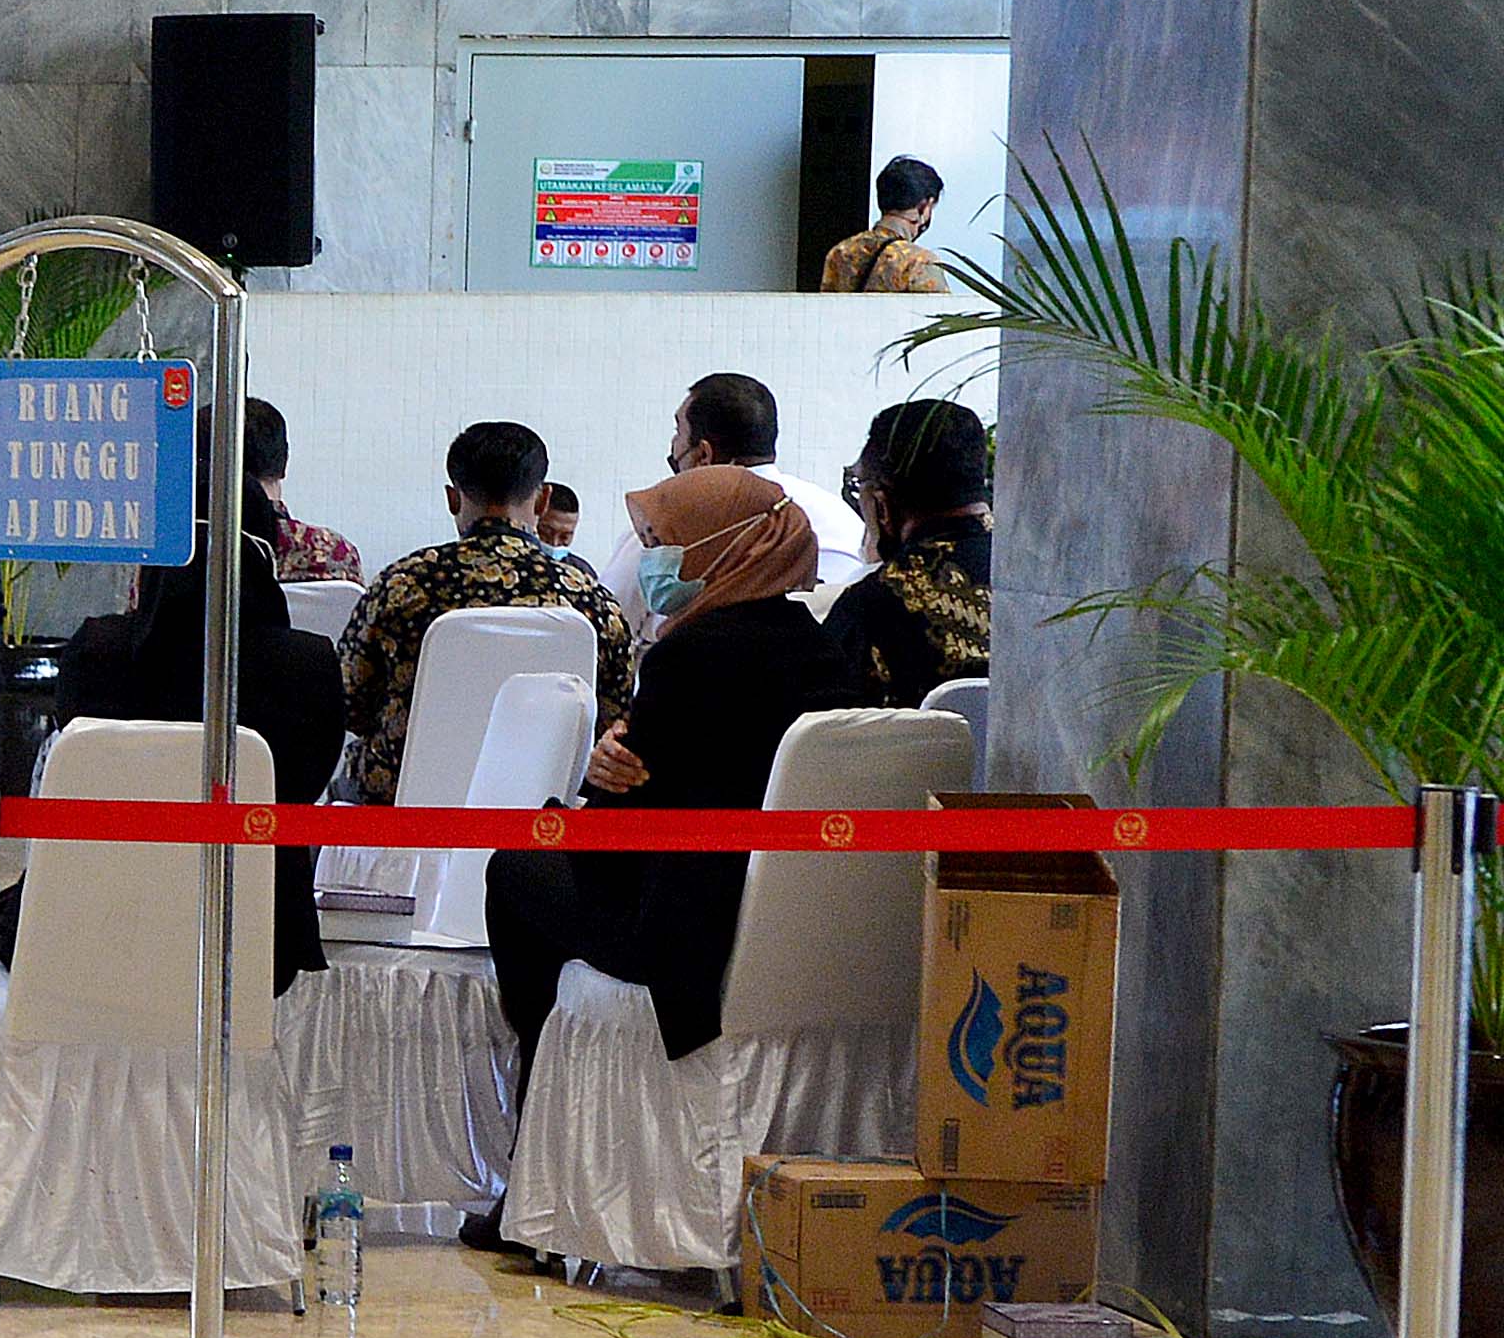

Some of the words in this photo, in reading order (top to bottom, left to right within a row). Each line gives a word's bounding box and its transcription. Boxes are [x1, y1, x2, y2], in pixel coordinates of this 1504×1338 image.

[540, 180, 592, 192] UTAMAKAN
[594, 181, 664, 194] KESELAMATAN
[18, 382, 129, 422] RUANG
[8, 441, 140, 481] TUNGGU
[1002, 962, 1072, 1111] AQUA
[875, 1246, 1025, 1304] AQUA
